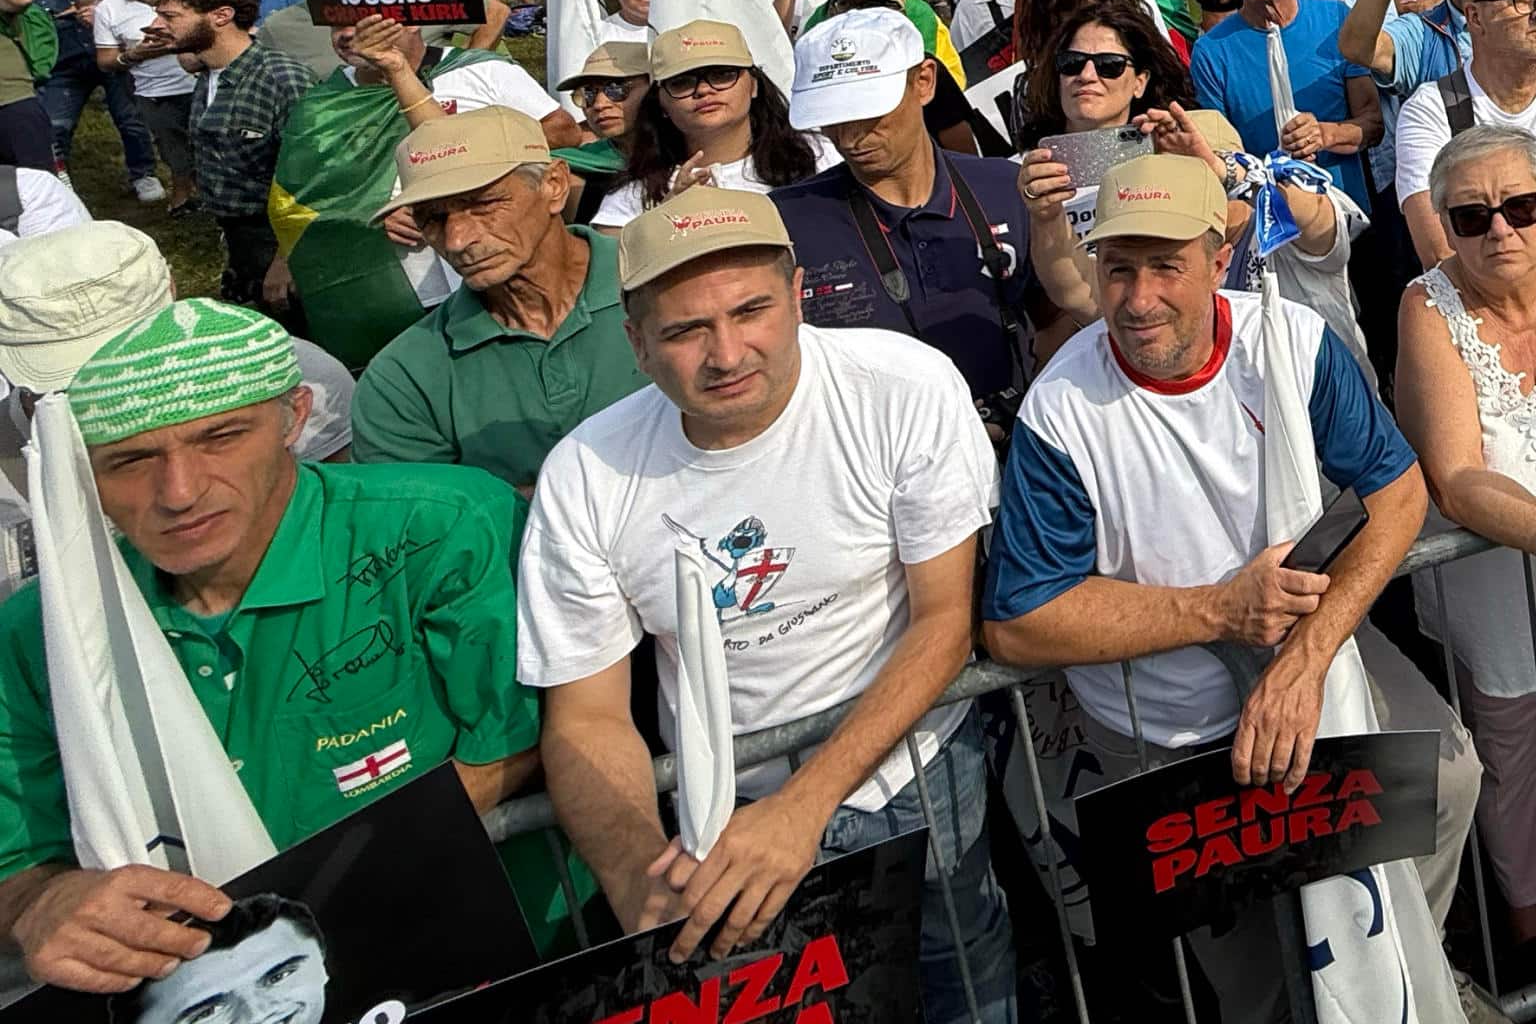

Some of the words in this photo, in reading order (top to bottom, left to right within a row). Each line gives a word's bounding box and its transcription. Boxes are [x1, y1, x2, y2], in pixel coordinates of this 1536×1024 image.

[410, 2, 469, 20] KIRK
[420, 145, 469, 165] PAURA
[1127, 191, 1172, 201] PAURA
[692, 216, 749, 229] PAURA
[759, 632, 774, 645] DA
[316, 708, 407, 752] PADANIA
[343, 762, 413, 799] LOMBARDIA
[1145, 768, 1385, 853] SENZA
[1151, 799, 1382, 895] PAURA
